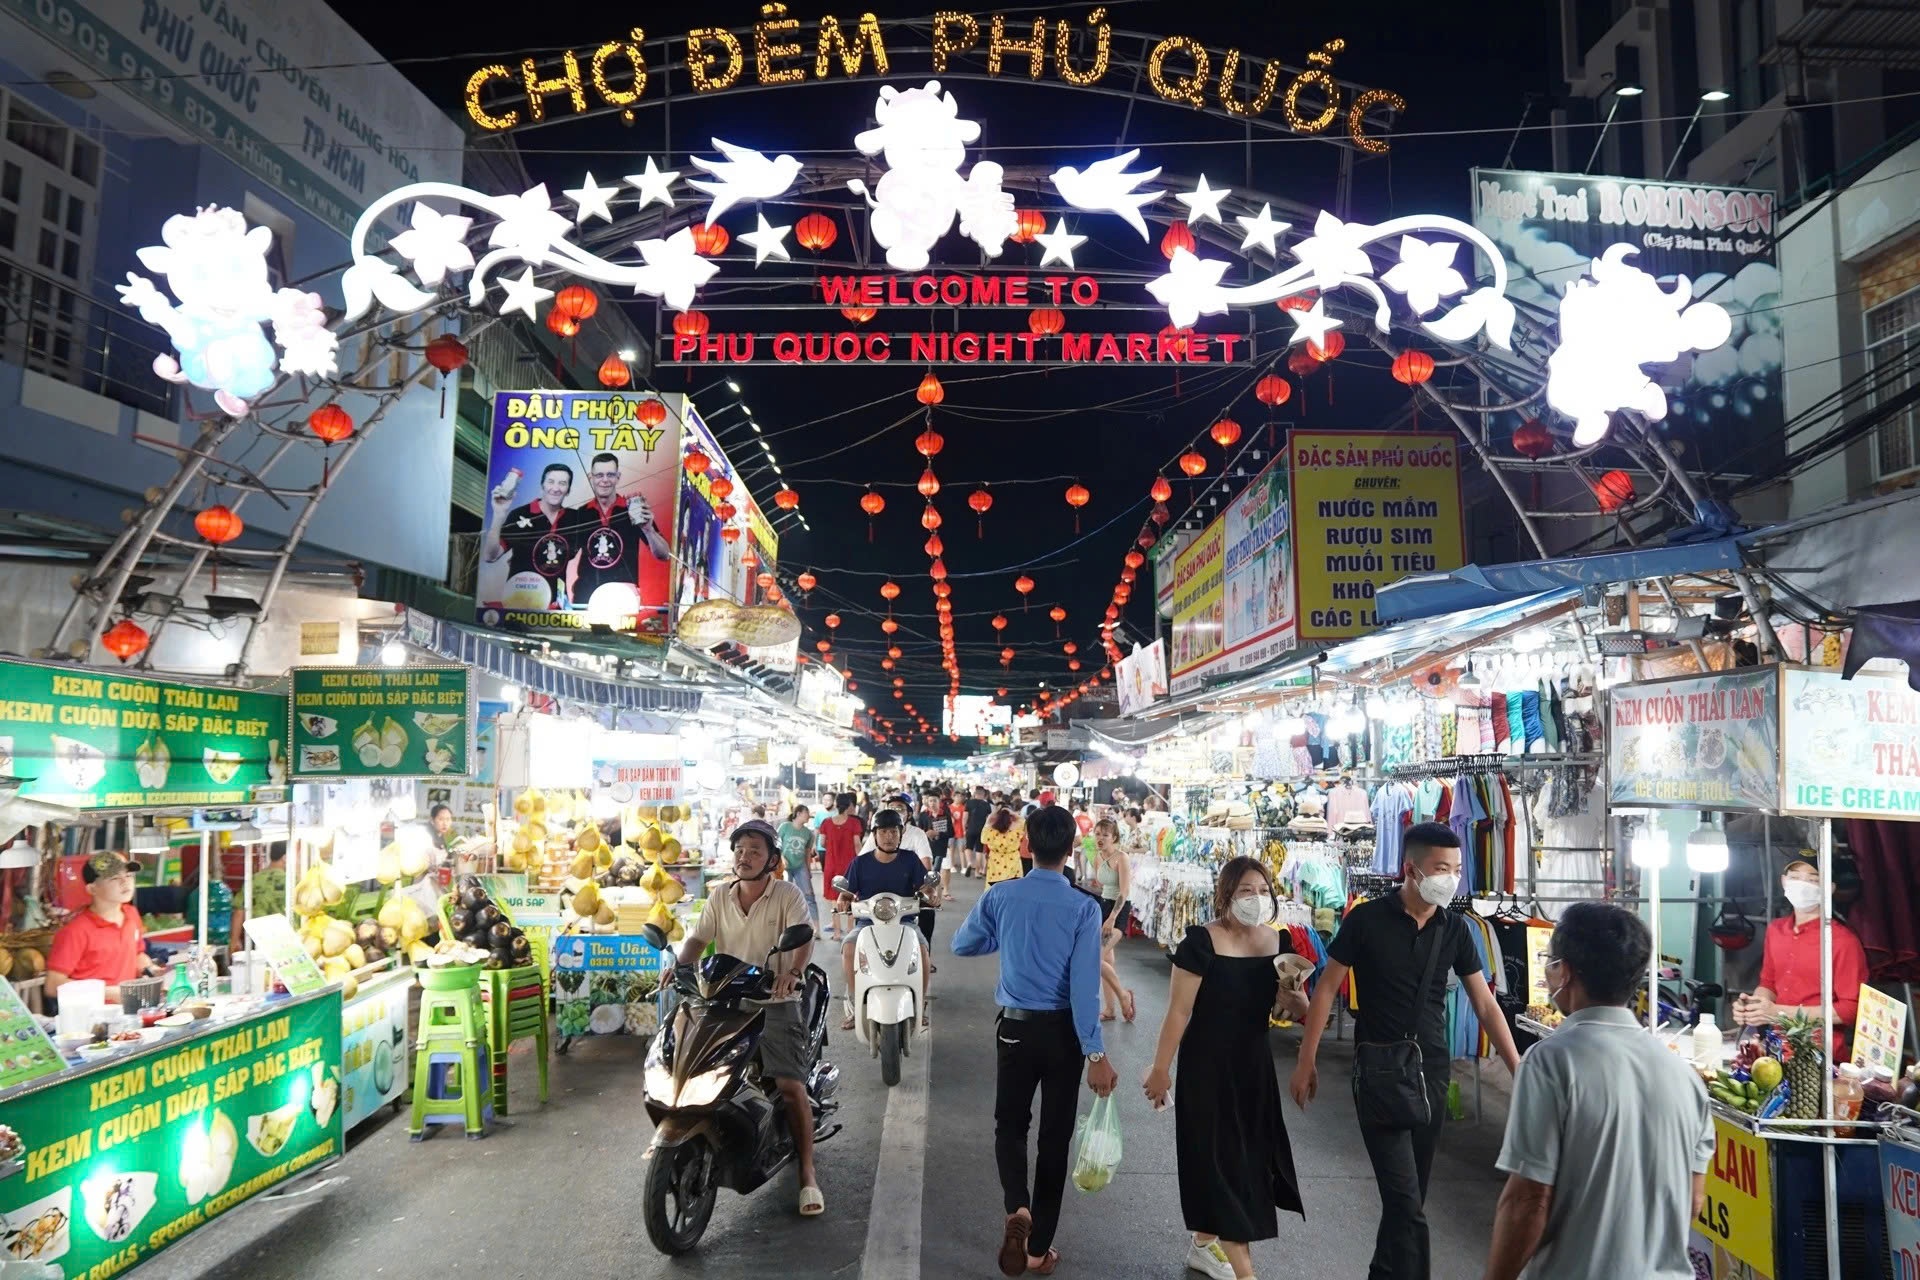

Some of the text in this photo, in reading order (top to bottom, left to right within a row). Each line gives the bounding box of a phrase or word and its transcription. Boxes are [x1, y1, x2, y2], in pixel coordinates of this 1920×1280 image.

[36, 0, 110, 62] 0903
[121, 53, 176, 105] 999
[184, 96, 217, 136] 812
[140, 0, 260, 113] PHÚ QUỐC
[464, 2, 1406, 153] CHỢ ĐÊM PHÚ QUỐC
[302, 116, 366, 194] TP.HCM
[1539, 185, 1589, 222] Trai
[1599, 182, 1773, 235] ROBINSON
[1706, 236, 1734, 252] Phú
[820, 276, 1099, 307] WELCOME TO
[673, 332, 1243, 364] PHU QUOC NIGHT MARKET
[507, 393, 564, 423] ĐẬU
[504, 422, 665, 451] ÔNG TÂY
[1298, 442, 1453, 471] ĐẶC SẢN PHÚ QUỐC
[1318, 495, 1438, 519] NƯỚC MẮM
[1326, 527, 1433, 548] RƯỢU SIM
[1326, 549, 1436, 572] MUỐI TIÊU
[1333, 579, 1375, 600] KHÔ
[1310, 606, 1352, 628] CÁC
[53, 676, 240, 712] KEM CUỘN THÁI LAN
[322, 671, 440, 690] KEM CUỘN THÁI LAN
[296, 690, 464, 709] KEM CUỘN DỪA SÁP ĐẶC BIỆT
[1615, 682, 1766, 732] KEM CUỘN THÁI LAN
[1867, 689, 1918, 725] KEM
[0, 700, 270, 741] KEM CUỘN DỪA SÁP ĐẶC BIỆT
[1635, 781, 1653, 799] ICE
[1656, 780, 1697, 800] CREAM
[1797, 784, 1920, 811] ICE CREAM
[590, 942, 650, 955] Thu Vân
[618, 957, 635, 967] 973
[89, 1016, 291, 1112] KEM CUỘN THÁI LAN
[25, 1037, 323, 1184] KEM CUỘN DỪA SÁP ĐẶC BIỆT
[89, 1243, 138, 1280] ROLLS
[149, 1207, 205, 1249] SPECIAL
